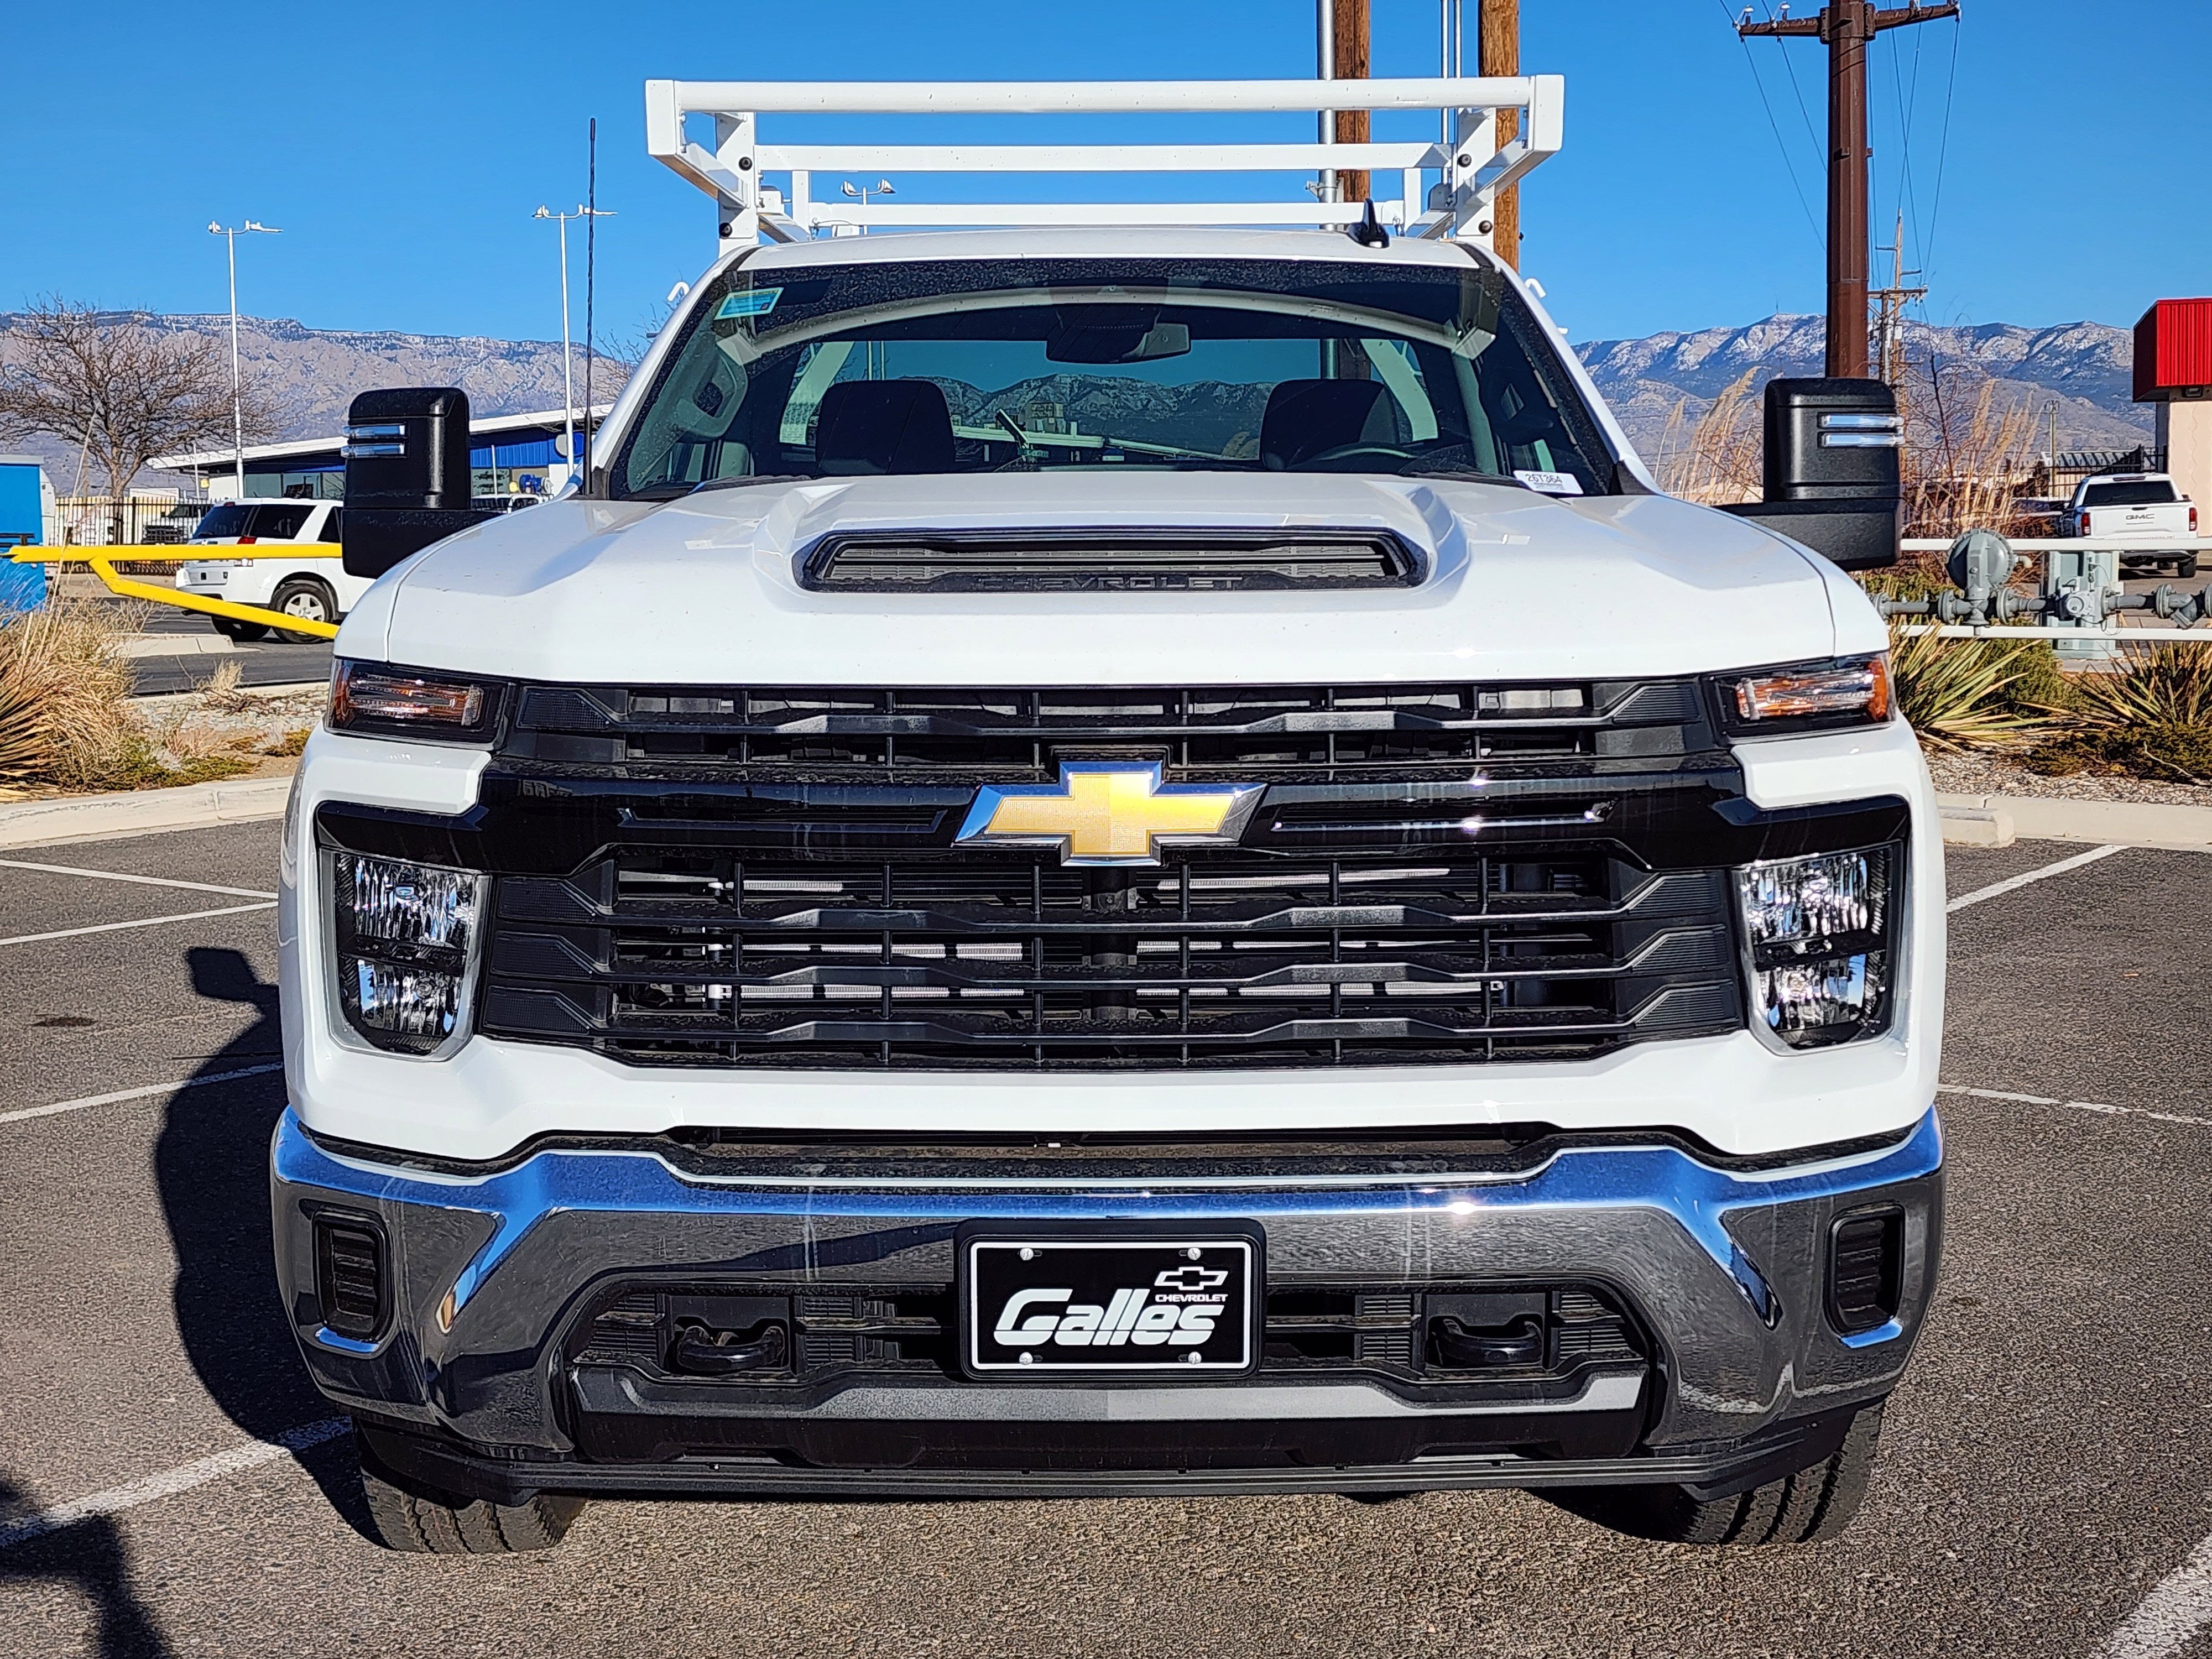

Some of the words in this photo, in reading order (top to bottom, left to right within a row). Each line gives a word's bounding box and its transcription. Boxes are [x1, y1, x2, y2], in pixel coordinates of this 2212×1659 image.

[976, 576, 1243, 589] CHEVROLET
[1155, 1294, 1228, 1302] CHEVROLET
[994, 1288, 1225, 1345] Galles
